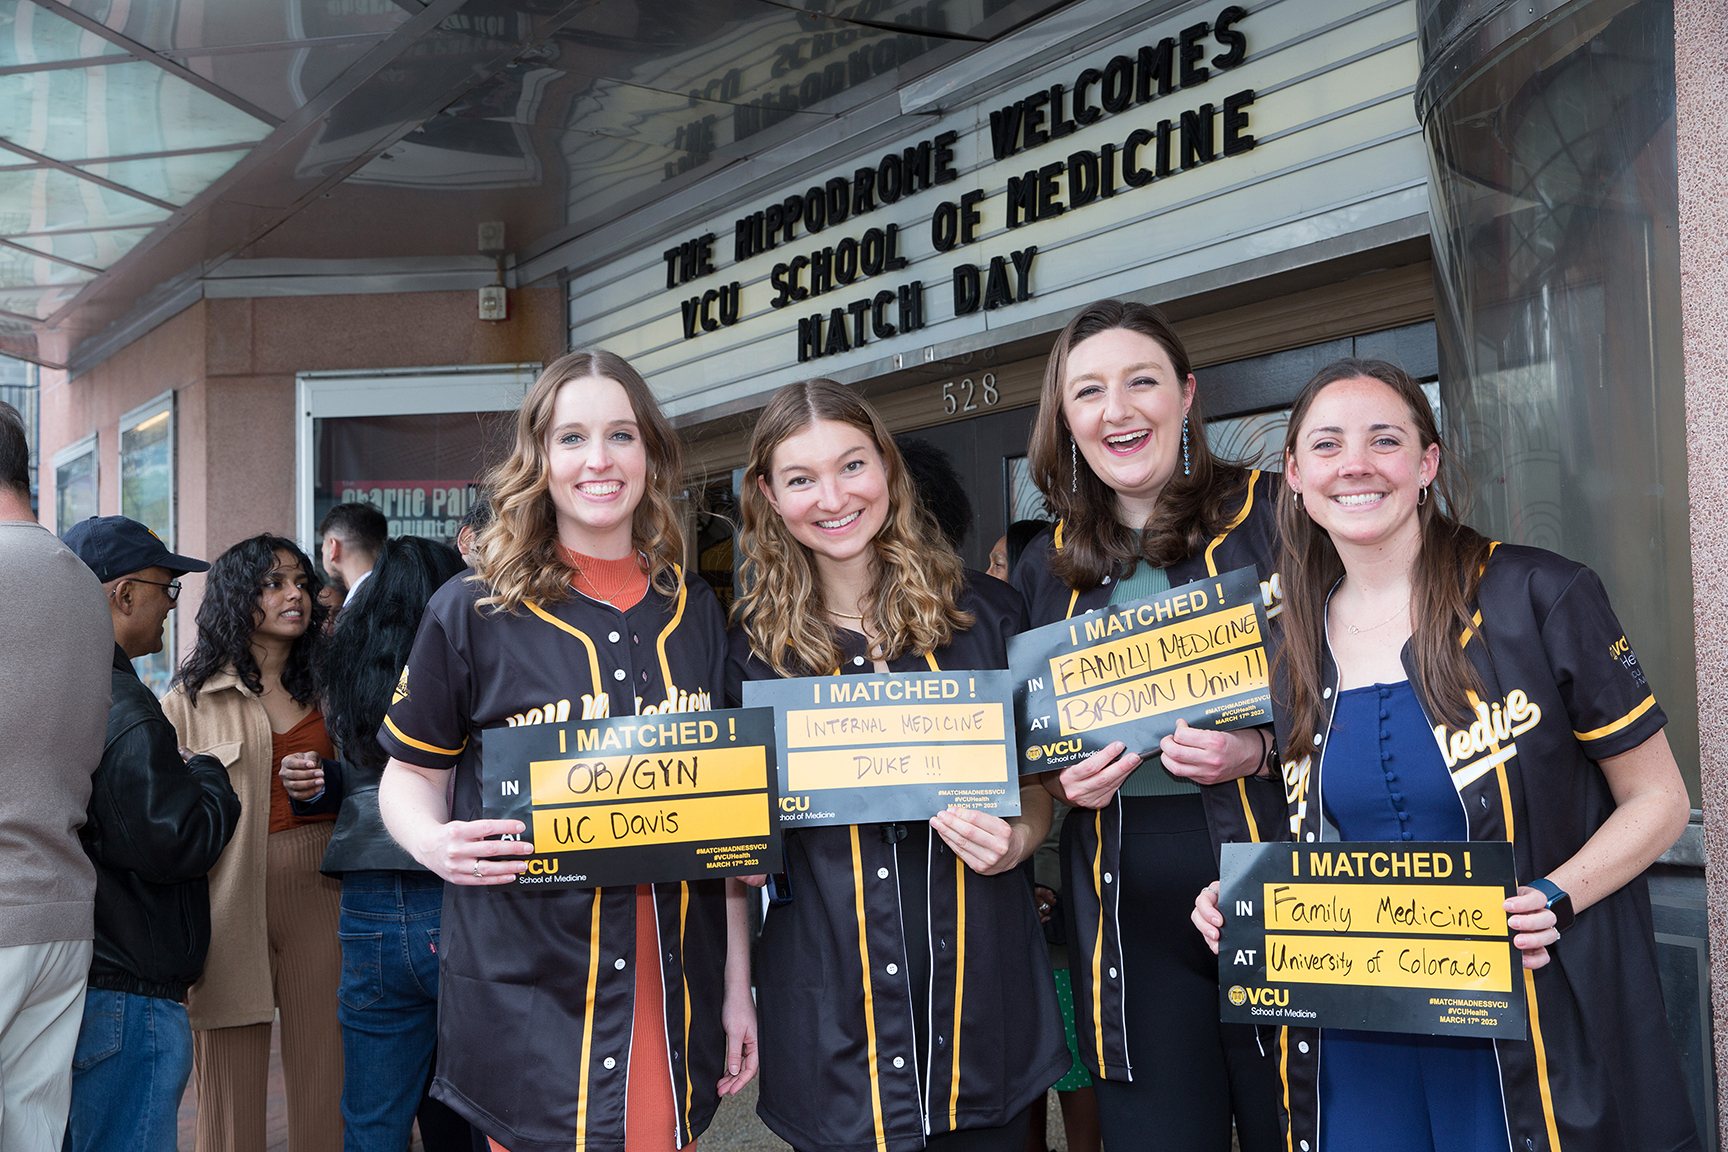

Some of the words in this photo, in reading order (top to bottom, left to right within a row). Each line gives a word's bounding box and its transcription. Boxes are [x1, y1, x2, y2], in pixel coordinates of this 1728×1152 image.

[664, 233, 715, 289] THE
[735, 131, 957, 261] HIPPODROME
[990, 5, 1247, 161] WELCOMES
[681, 281, 740, 339] VCU
[771, 223, 906, 308] SCHOOL
[932, 189, 984, 252] OF
[1006, 89, 1255, 229] MEDICINE
[798, 280, 924, 362] MATCH
[953, 244, 1038, 316] DAY
[943, 373, 998, 415] 528
[1069, 625, 1078, 646] I
[1085, 590, 1208, 642] MATCHED
[1215, 583, 1225, 605] !
[1059, 642, 1152, 694] FAMILY
[1157, 613, 1257, 662] MEDICINE
[814, 683, 820, 704] I
[830, 679, 959, 703] MATCHED
[969, 677, 976, 698] !
[1028, 677, 1044, 693] IN
[1062, 678, 1176, 731] BROWN
[1187, 668, 1240, 700] Univ
[805, 714, 886, 738] INTERNAL
[901, 710, 985, 735] MEDICINE
[1030, 715, 1050, 731] AT
[1215, 715, 1238, 725] MARCH
[1250, 709, 1264, 717] 2023
[558, 729, 567, 753] I
[577, 720, 719, 752] MATCHED
[729, 717, 737, 742] !
[1042, 738, 1082, 757] VCU
[853, 755, 911, 779] DUKE
[1047, 755, 1069, 765] School
[567, 755, 698, 794] OB/GYN
[501, 780, 519, 796] IN
[796, 812, 804, 820] of
[805, 811, 835, 819] Medicine
[554, 816, 596, 845] UC
[611, 810, 679, 840] Davis
[706, 861, 731, 869] MARCH
[1292, 851, 1299, 877] I
[1310, 852, 1453, 878] MATCHED
[1463, 851, 1473, 879] !
[519, 875, 543, 884] School
[545, 875, 553, 883] of
[554, 873, 587, 883] Medicine
[1235, 900, 1253, 916] IN
[1273, 886, 1352, 933] Family
[1376, 895, 1490, 931] Medicine
[1233, 950, 1257, 966] AT
[1271, 942, 1353, 977] University
[1367, 950, 1384, 973] of
[1398, 947, 1491, 977] Colorado
[1246, 987, 1289, 1007] VCU
[1429, 998, 1508, 1009] #MATCHMADNESSVCU
[1251, 1006, 1275, 1016] School
[1275, 1008, 1283, 1017] of
[1284, 1009, 1317, 1019] Medicine
[1439, 1016, 1466, 1024] MARCH
[1481, 1018, 1498, 1026] 2023
[1448, 1007, 1489, 1016] #VCUHealth
